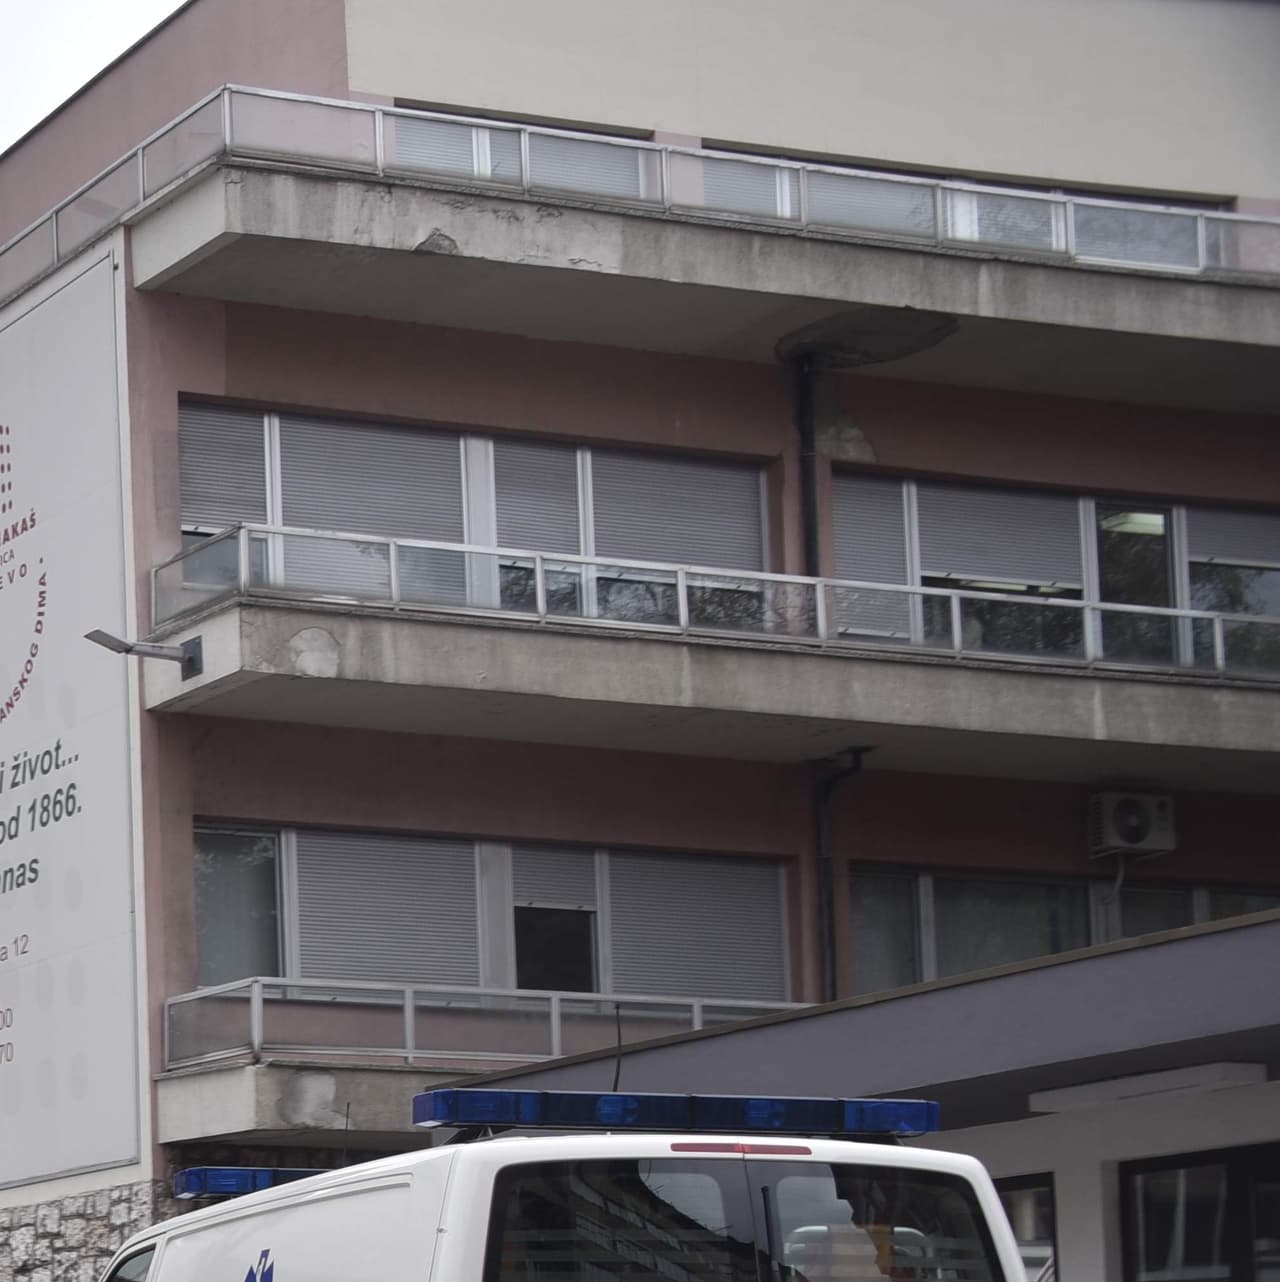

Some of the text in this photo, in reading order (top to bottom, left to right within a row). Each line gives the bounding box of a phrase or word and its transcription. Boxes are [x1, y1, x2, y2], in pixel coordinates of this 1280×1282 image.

[34, 572, 47, 635] DIMA
[10, 738, 80, 789] život...
[28, 783, 82, 832] 1866.
[13, 934, 29, 956] 12
